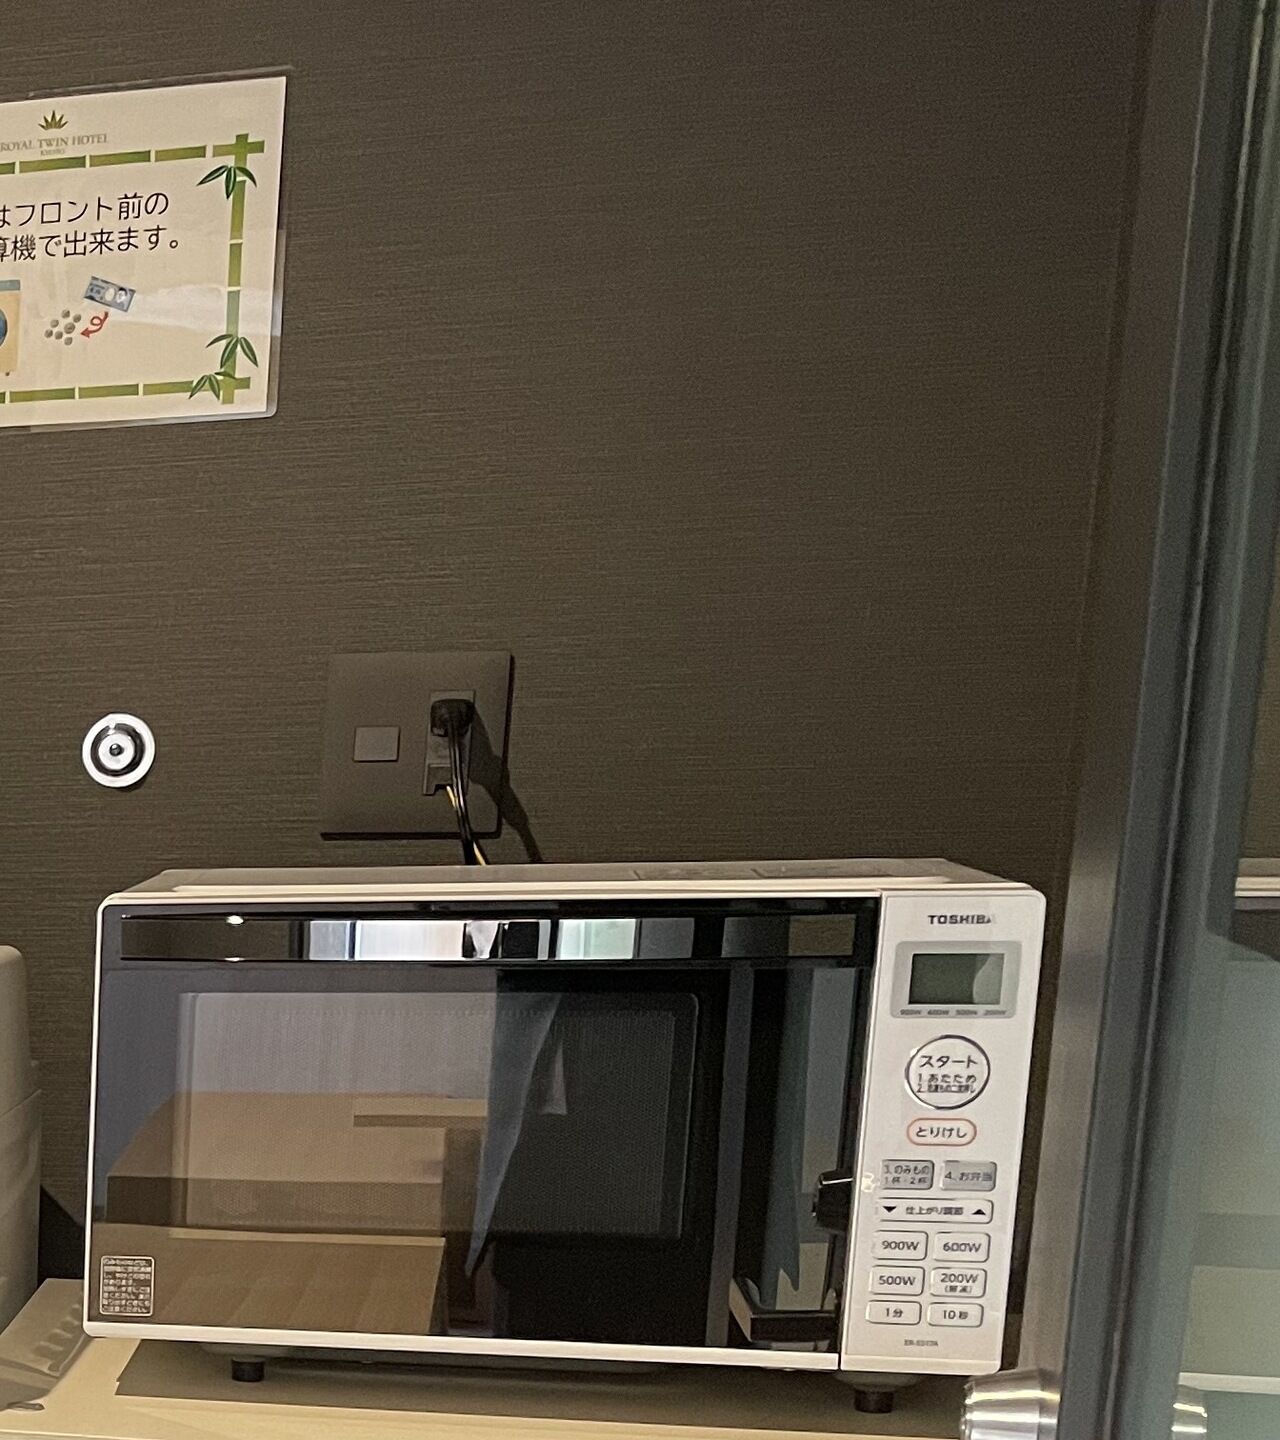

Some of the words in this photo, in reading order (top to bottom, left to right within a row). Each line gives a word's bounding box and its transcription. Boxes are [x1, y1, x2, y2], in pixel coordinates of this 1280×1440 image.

[0, 140, 32, 152] ROYAL
[39, 137, 69, 149] TWIN
[72, 133, 108, 146] HOTEL
[928, 914, 995, 925] TOSHIBA
[919, 1055, 978, 1069] スタート
[916, 1126, 967, 1138] とりけし
[882, 1240, 920, 1250] 900W
[943, 1242, 981, 1253] 600W
[879, 1276, 916, 1286] 500W
[940, 1273, 978, 1284] 200W
